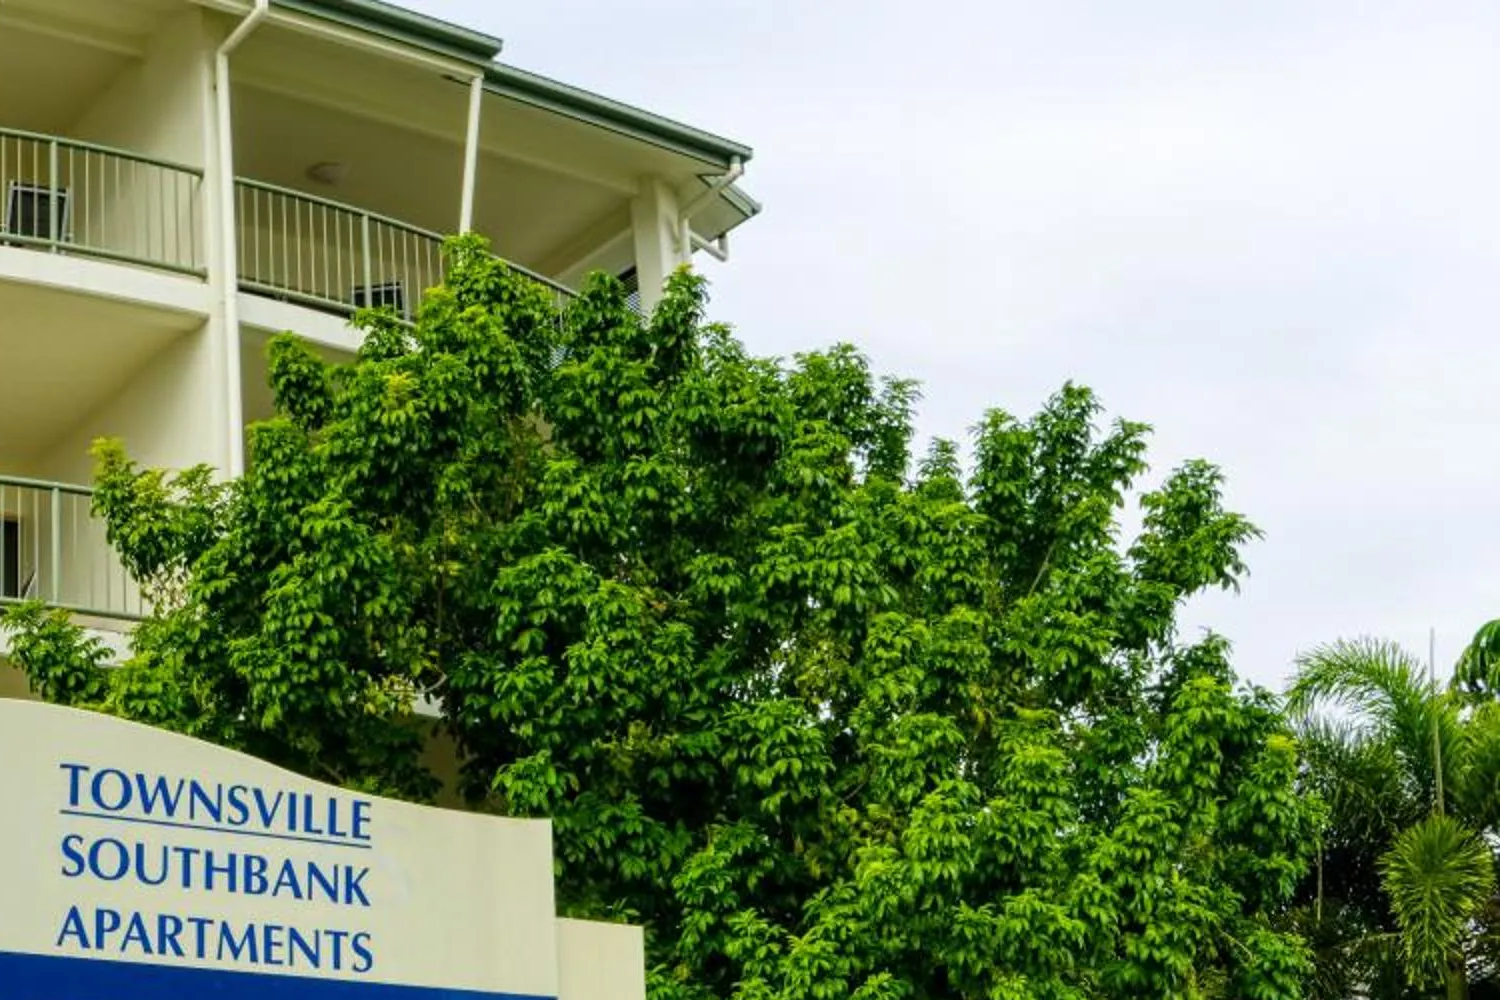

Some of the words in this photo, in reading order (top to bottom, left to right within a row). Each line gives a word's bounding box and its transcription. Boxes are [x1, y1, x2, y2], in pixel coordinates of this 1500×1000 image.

[59, 763, 372, 841] TOWNSVILLE
[60, 834, 371, 907] SOUTHBANK
[56, 905, 373, 973] APARTMENTS
